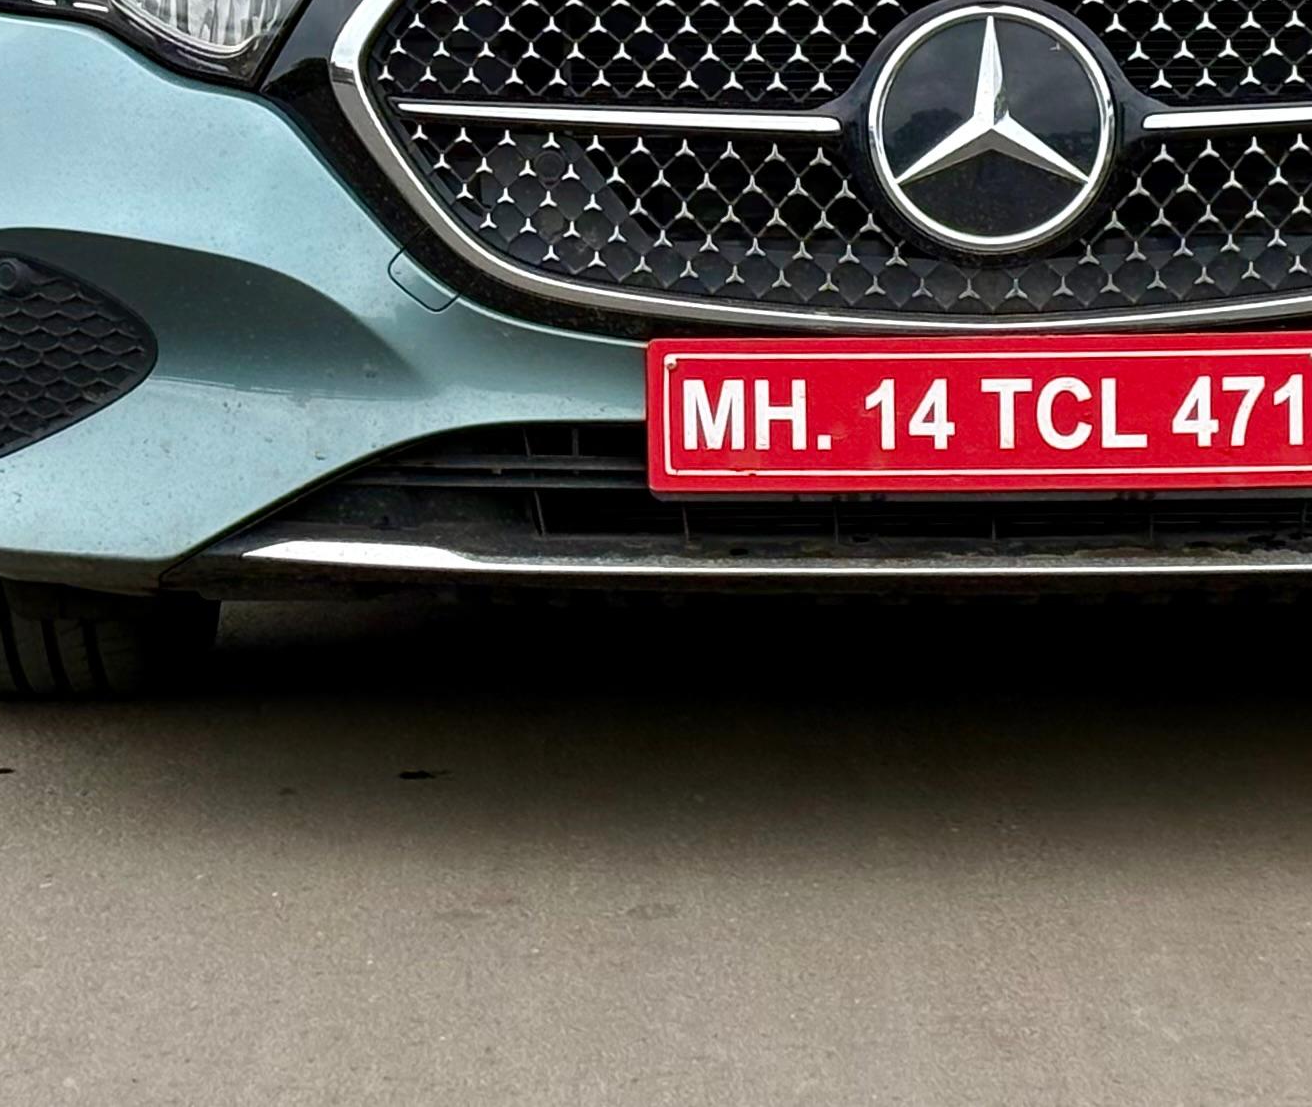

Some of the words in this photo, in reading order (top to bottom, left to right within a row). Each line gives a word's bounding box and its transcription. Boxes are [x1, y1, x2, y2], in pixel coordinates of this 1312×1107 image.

[683, 379, 832, 450] MH.
[865, 378, 956, 450] 14
[980, 377, 1148, 450] TCL
[1172, 373, 1304, 447] 471
